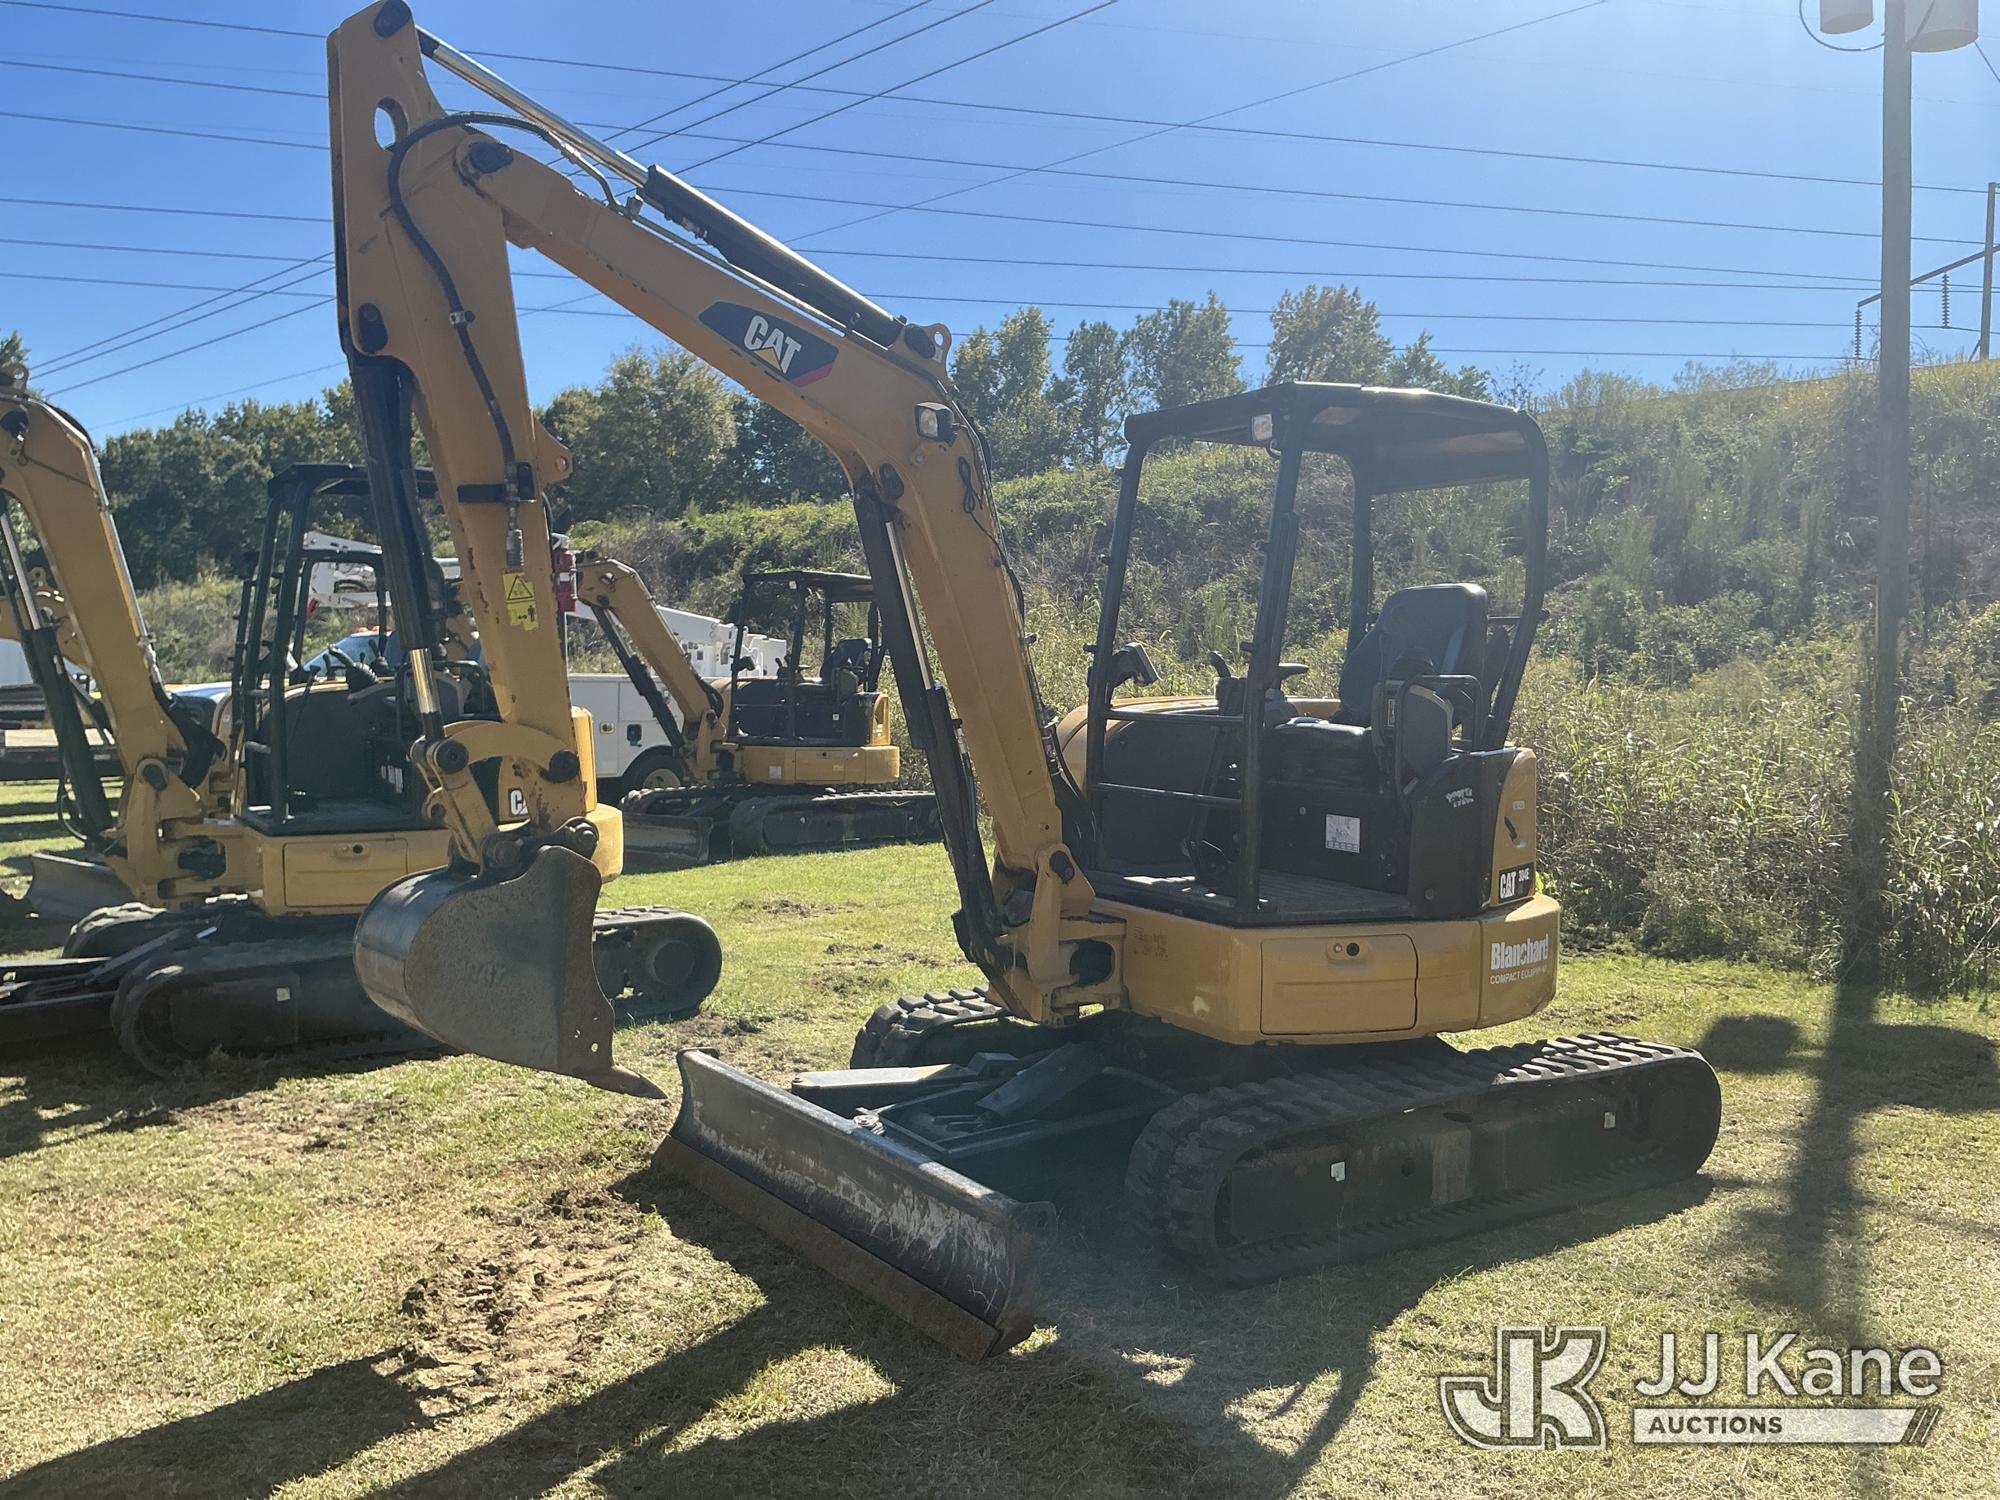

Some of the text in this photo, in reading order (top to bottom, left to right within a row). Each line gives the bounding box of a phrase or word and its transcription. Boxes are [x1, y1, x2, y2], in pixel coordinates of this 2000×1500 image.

[744, 315, 802, 374] CAT
[1500, 871, 1517, 899] CAT
[1491, 933, 1549, 970] Blanchard
[1490, 970, 1520, 985] COMPACT
